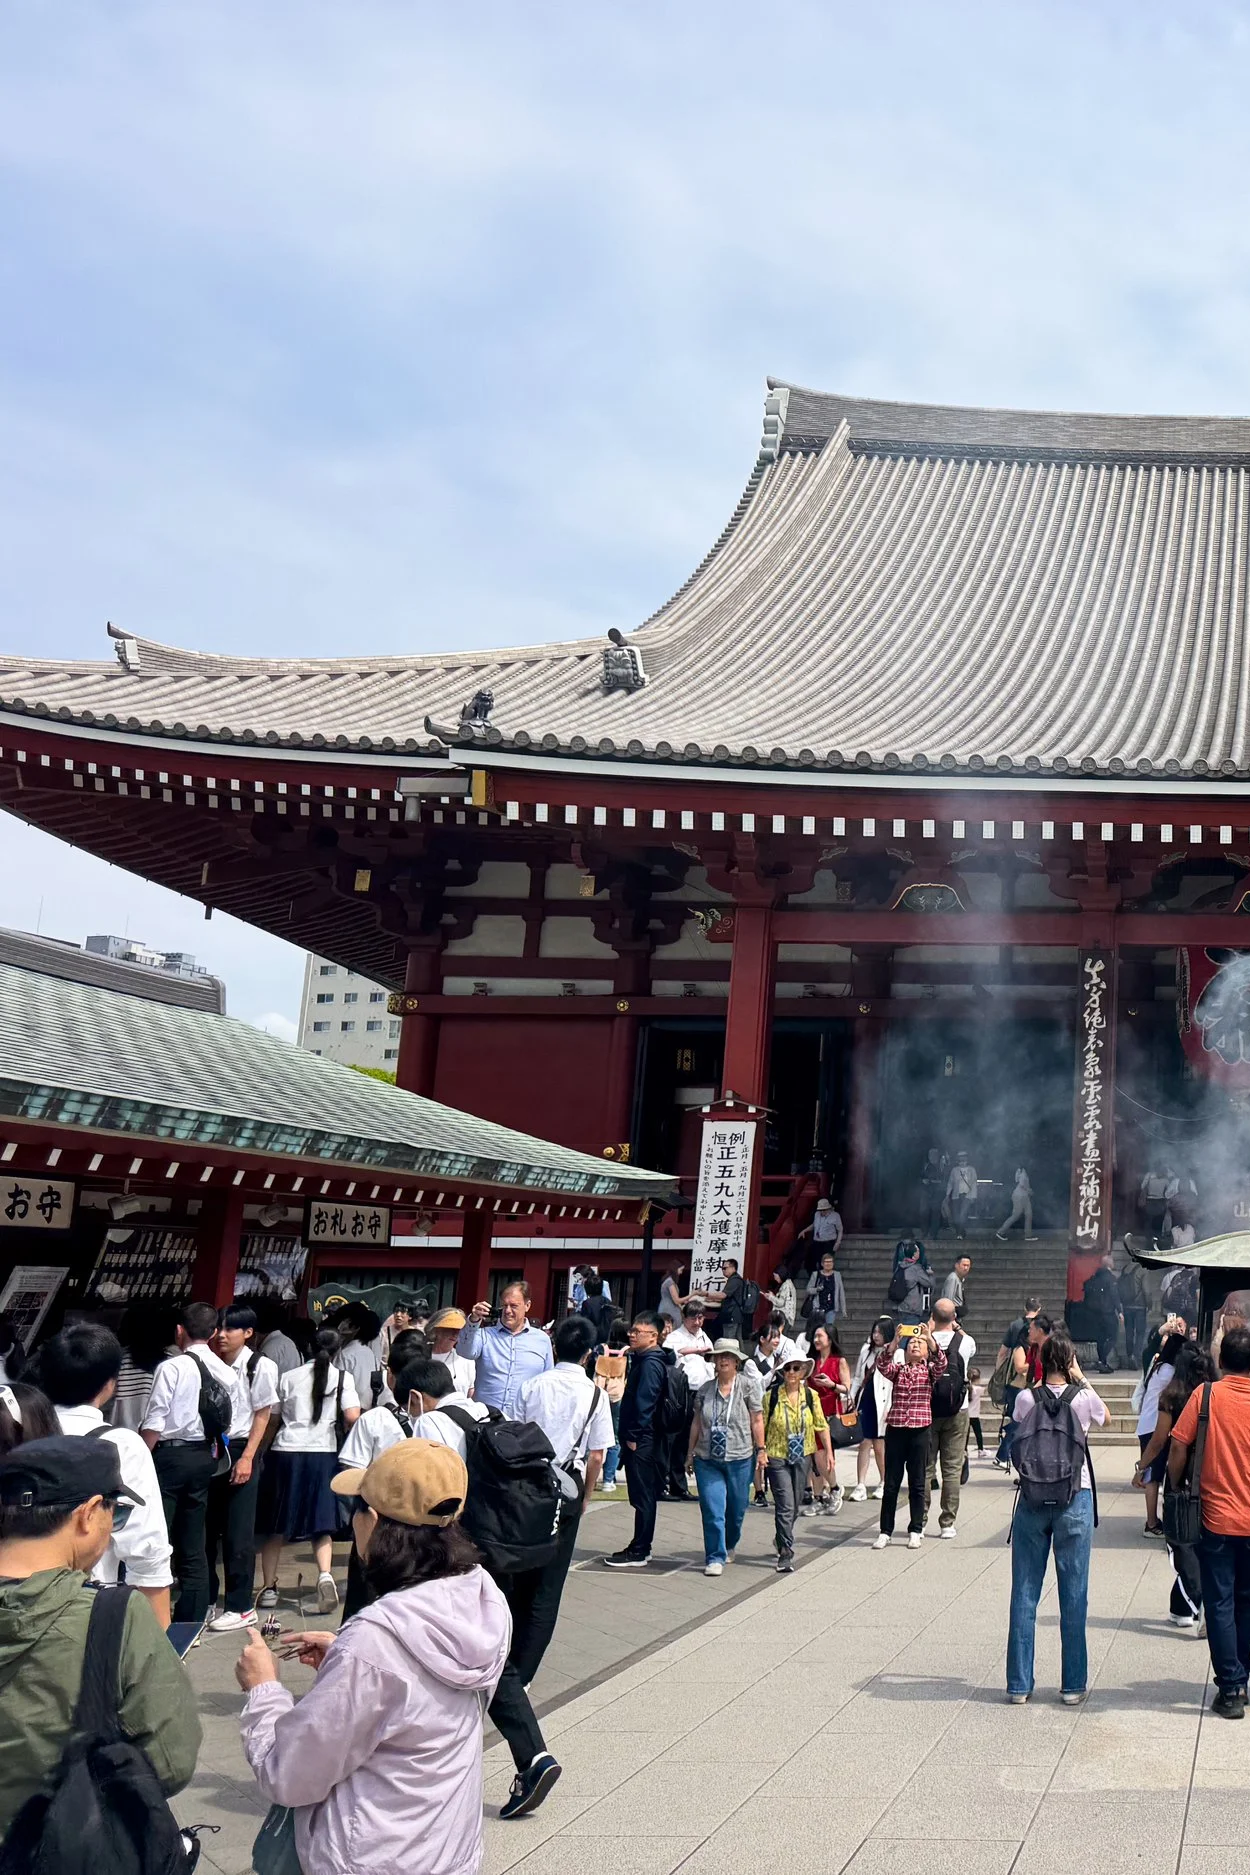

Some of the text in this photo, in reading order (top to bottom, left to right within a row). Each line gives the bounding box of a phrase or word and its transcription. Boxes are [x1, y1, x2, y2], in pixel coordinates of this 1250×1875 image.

[711, 1130, 746, 1146] 恒例
[4, 1182, 62, 1224] お守
[703, 1146, 738, 1291] 正五九大護摩執行
[313, 1207, 381, 1239] お札お守
